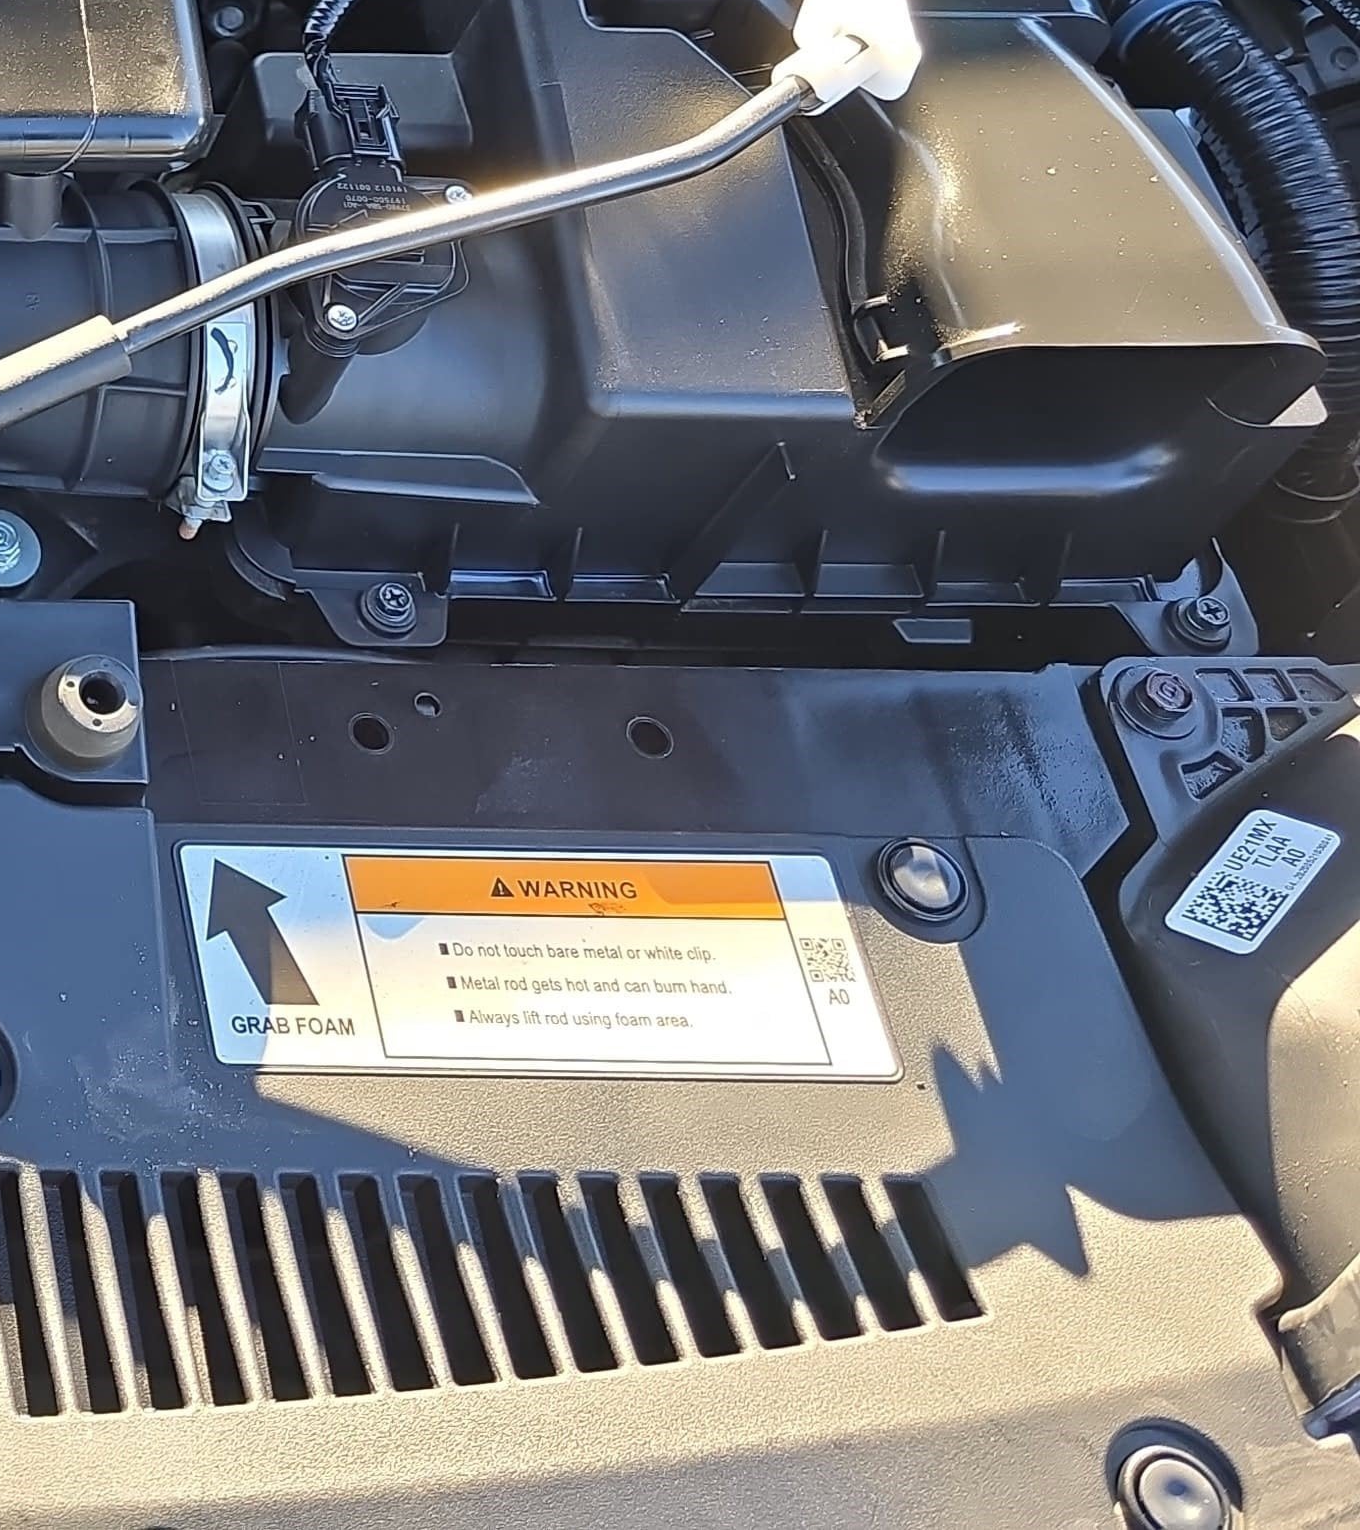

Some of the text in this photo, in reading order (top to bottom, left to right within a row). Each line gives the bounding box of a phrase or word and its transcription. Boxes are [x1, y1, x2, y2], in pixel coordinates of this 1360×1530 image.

[1224, 818, 1278, 871] UE21MX
[1251, 835, 1292, 868] TLAA
[517, 880, 638, 900] WARNING
[453, 942, 716, 963] Do not touch bare metal or white clip.
[460, 976, 732, 995] Metal rod gets hot and can burn hand.
[231, 1015, 356, 1037] GRAB FOAM
[469, 1009, 694, 1029] Always lift rod using foam area.
